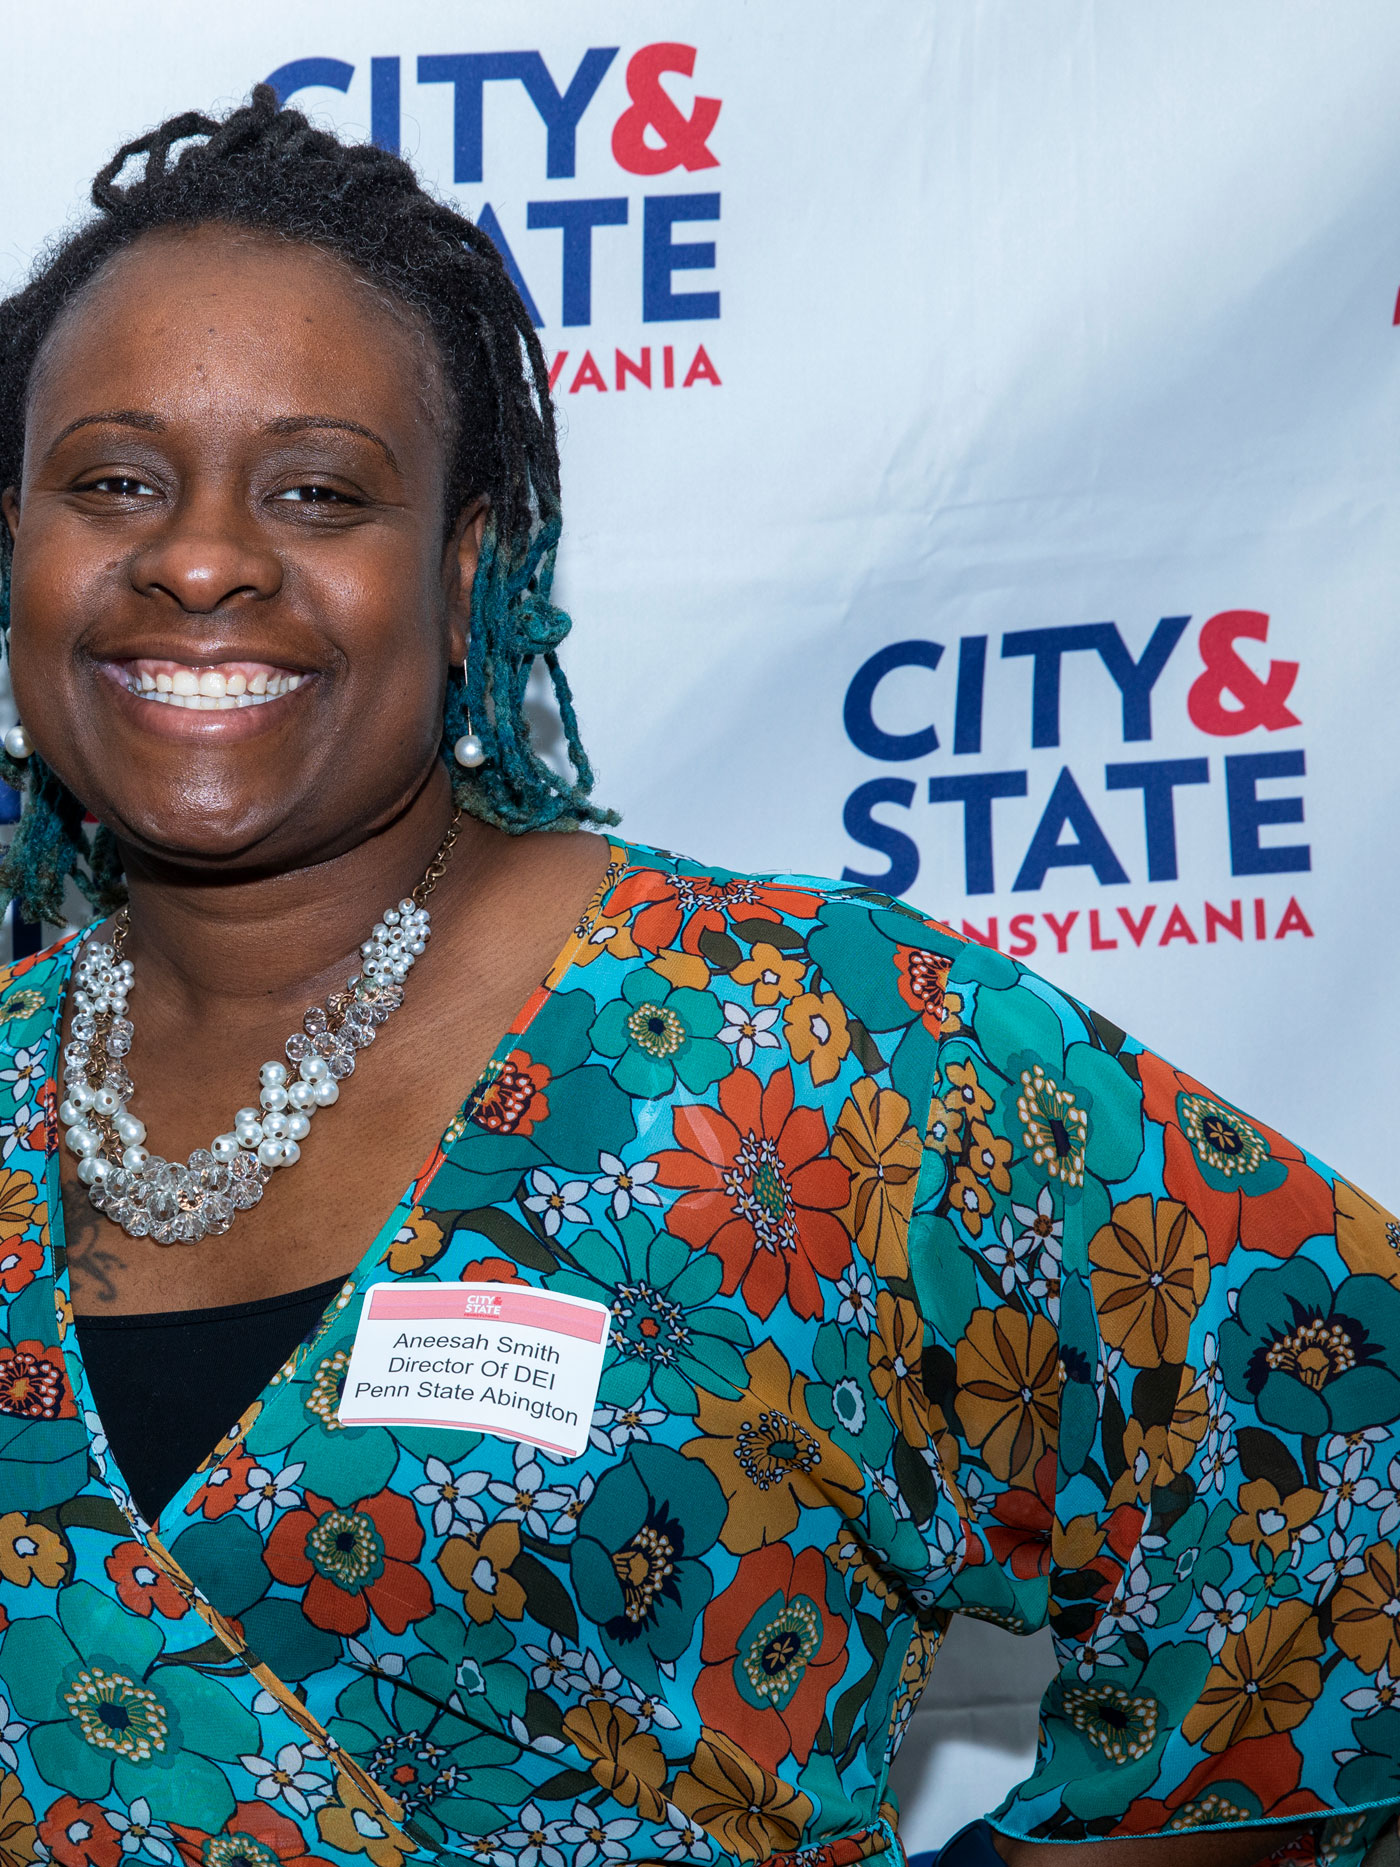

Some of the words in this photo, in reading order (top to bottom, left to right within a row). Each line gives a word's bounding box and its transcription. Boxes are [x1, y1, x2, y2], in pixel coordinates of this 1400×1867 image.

[842, 609, 1303, 762] CITY&
[840, 749, 1312, 898] STATE
[940, 896, 1315, 957] NSYLVANIA
[464, 1303, 501, 1315] STATE
[467, 1295, 502, 1305] CITY&
[393, 1333, 489, 1350] Aneesah
[496, 1336, 560, 1364] Smith
[388, 1357, 474, 1374] Director
[481, 1360, 508, 1378] Of
[514, 1365, 556, 1390] DEI
[355, 1382, 410, 1399] Penn
[417, 1382, 475, 1401] State
[480, 1387, 579, 1427] Abington
